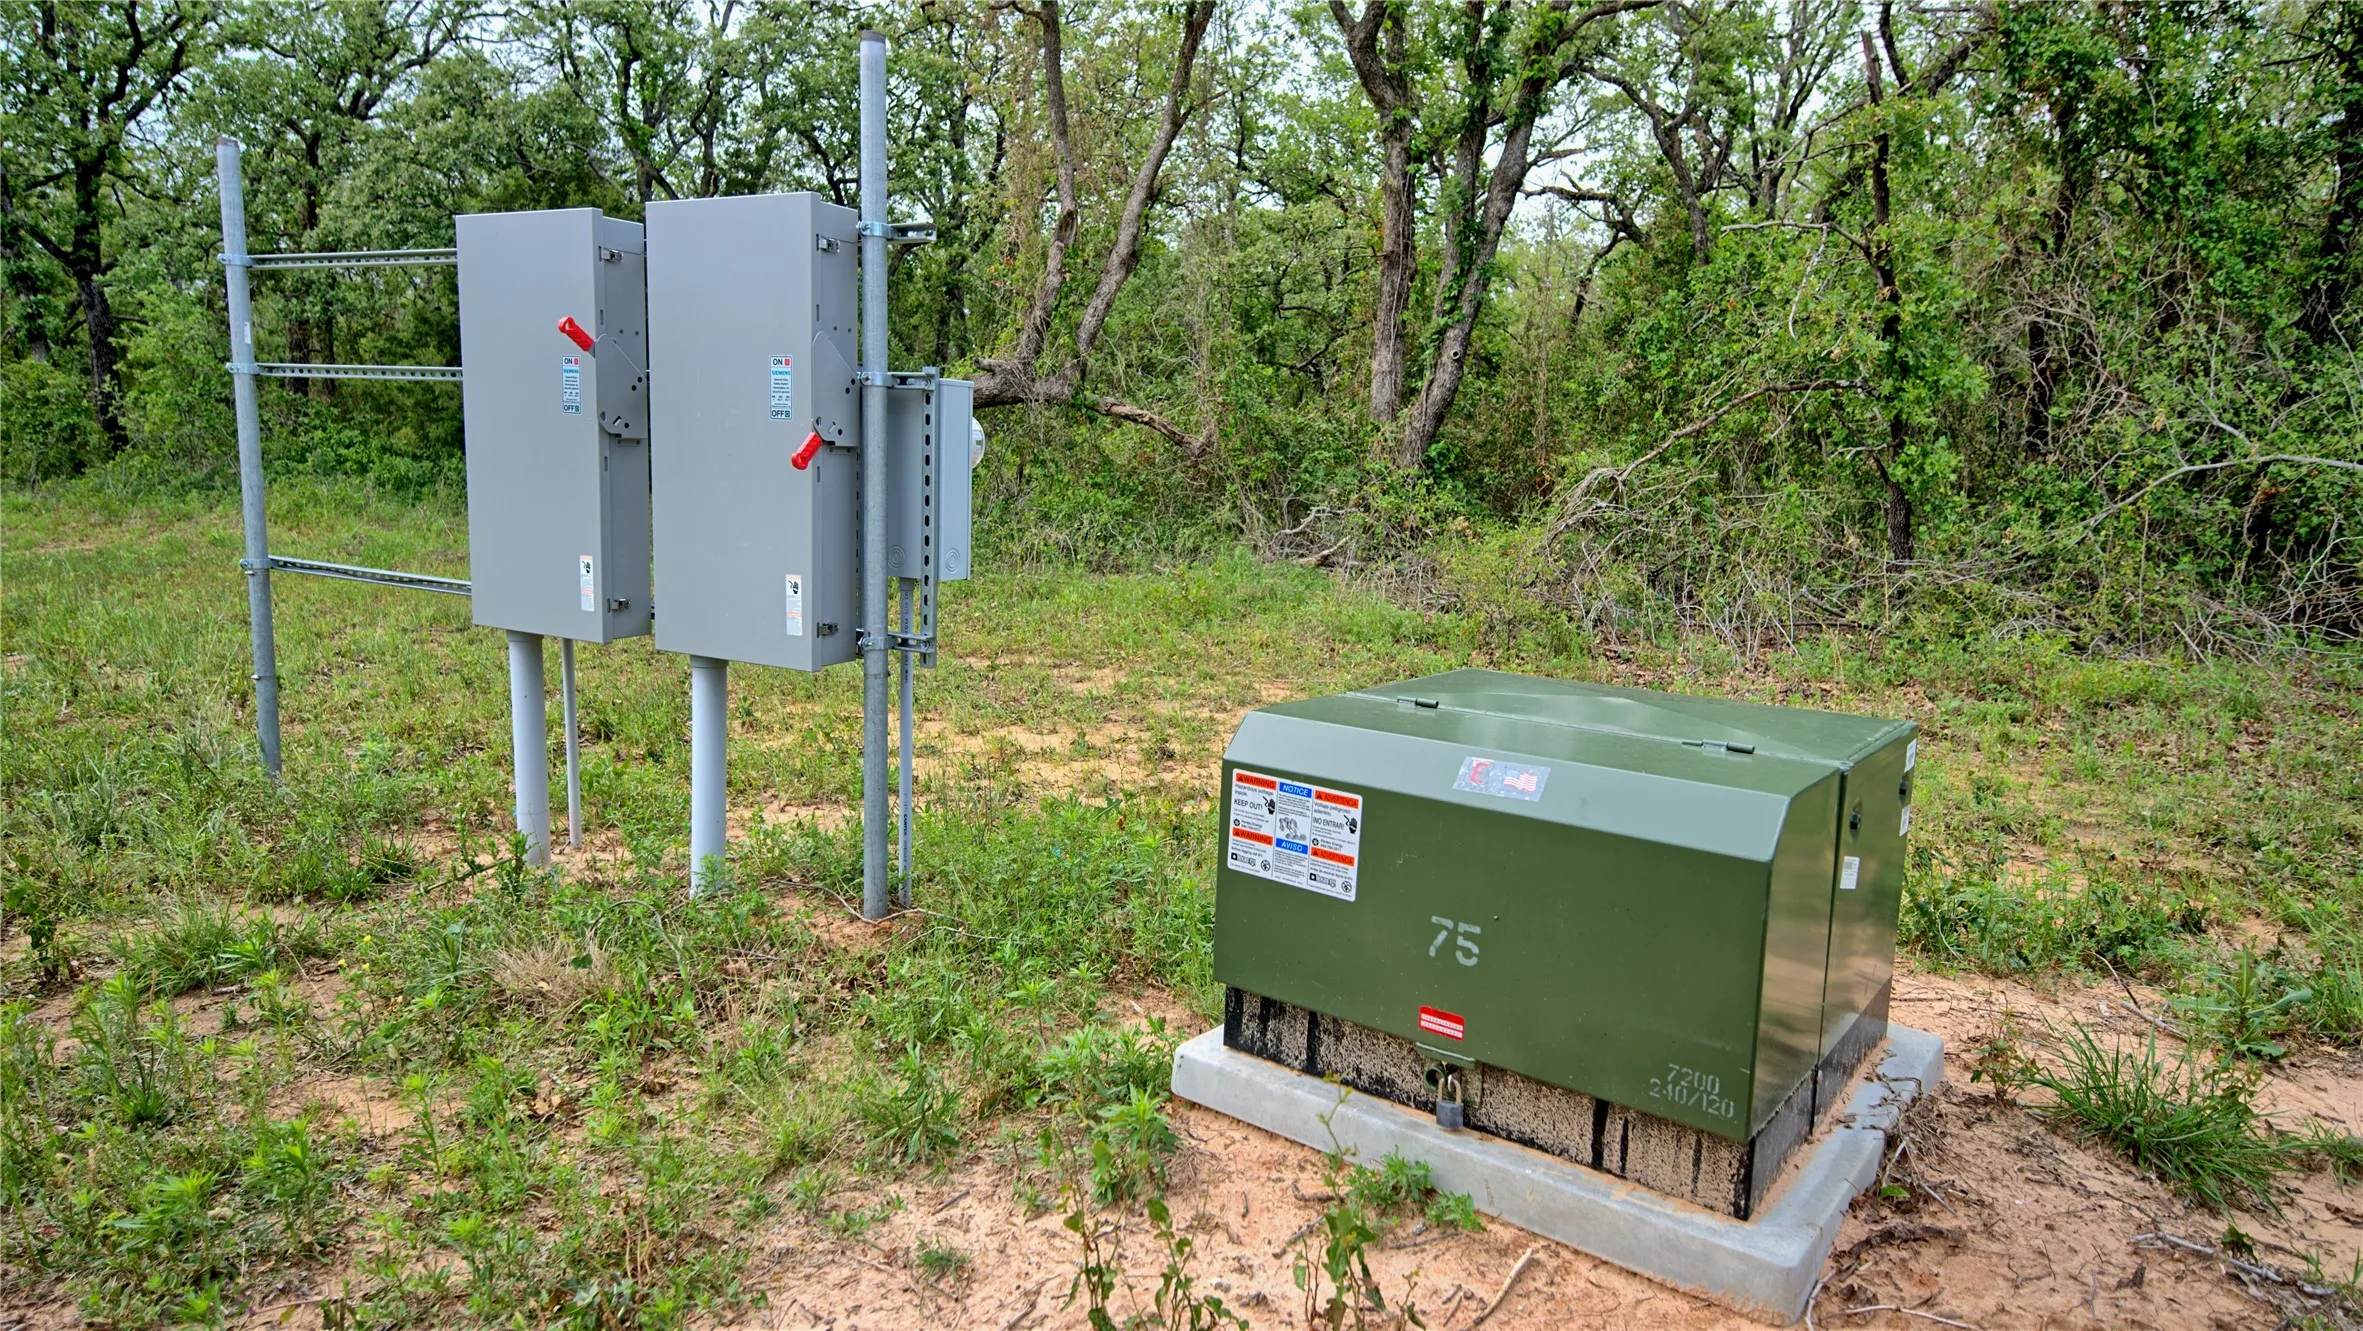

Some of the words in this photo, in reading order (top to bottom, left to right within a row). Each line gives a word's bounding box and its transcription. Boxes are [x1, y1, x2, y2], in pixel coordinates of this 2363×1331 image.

[564, 357, 573, 365] ON
[772, 358, 783, 366] ON
[771, 409, 785, 417] OFF
[1243, 775, 1275, 789] WARNING
[1282, 784, 1309, 796] NOTICE
[1233, 798, 1249, 807] KEEP
[1249, 801, 1263, 810] OUT!
[1324, 794, 1357, 807] ADVERTENCIA
[1322, 819, 1345, 830] ENTRAR!
[1241, 830, 1271, 843] WARNING
[1281, 841, 1303, 852] AVISO
[1320, 851, 1353, 865] ADVERTENCIA
[1429, 915, 1481, 966] 75
[1667, 1063, 1720, 1094] 7200
[1649, 1078, 1735, 1118] 240/120
